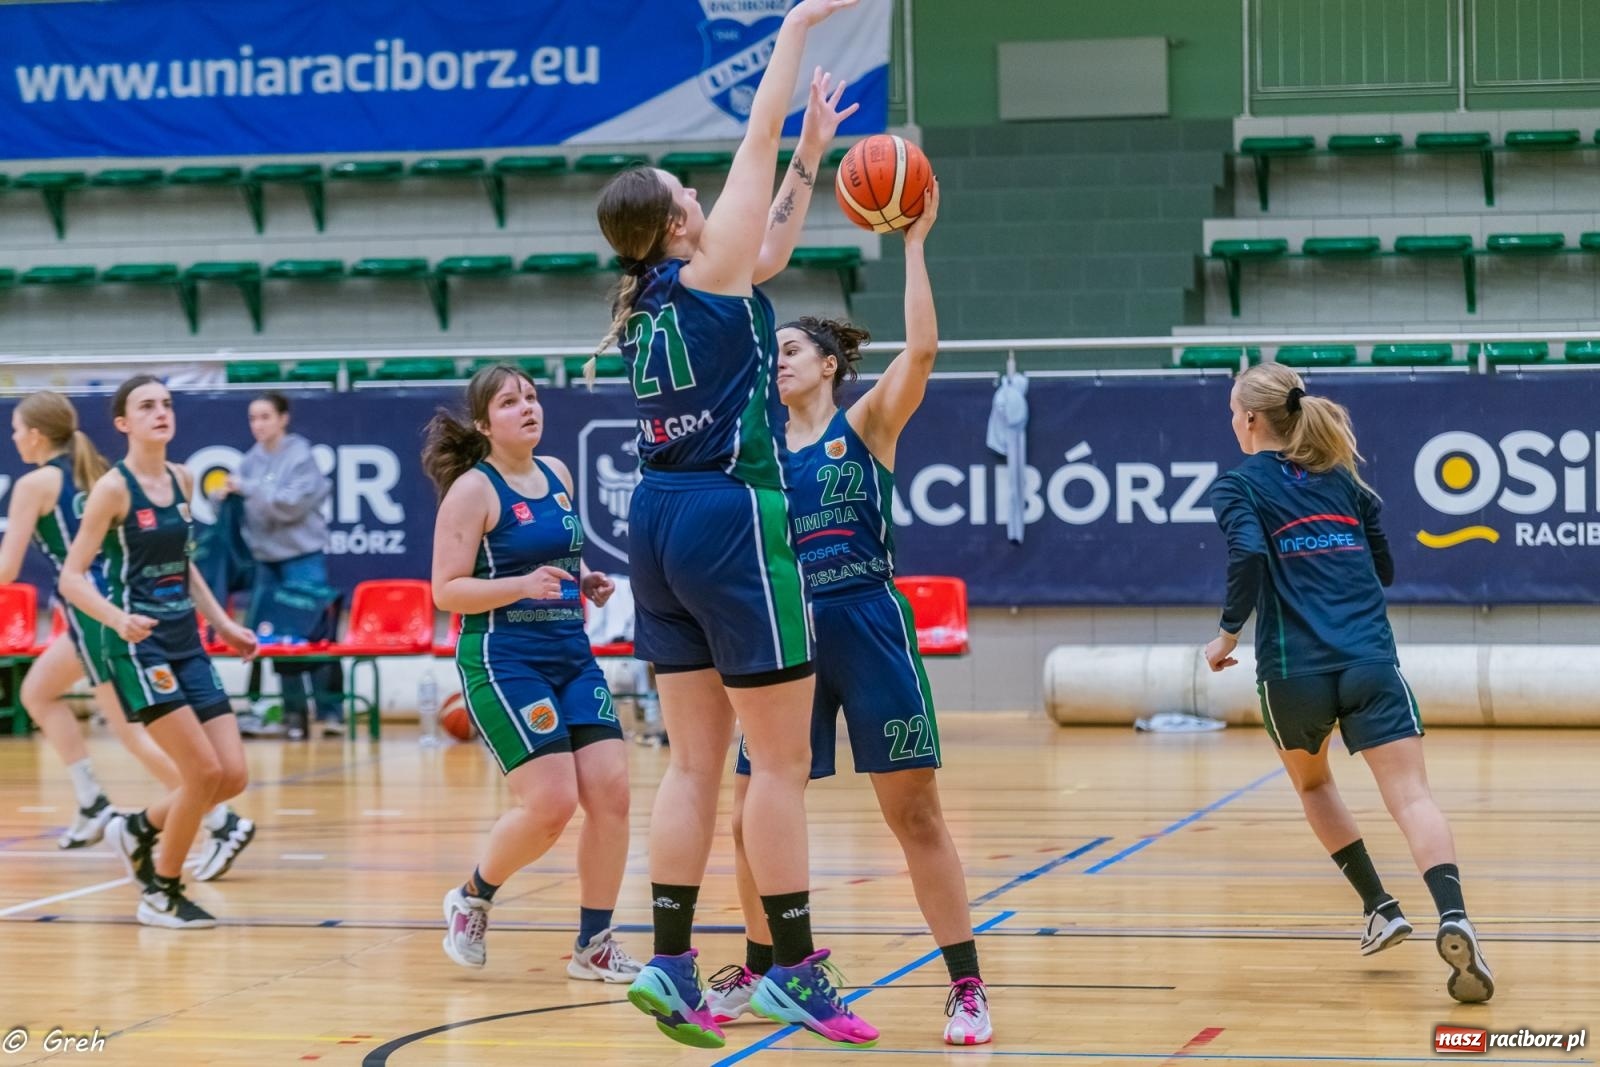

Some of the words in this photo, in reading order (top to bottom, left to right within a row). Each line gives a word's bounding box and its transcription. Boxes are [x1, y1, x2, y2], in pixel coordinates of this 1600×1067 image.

[16, 39, 600, 102] www.uniaraciborz.eu
[624, 302, 697, 399] 21
[817, 461, 867, 506] 22
[1414, 429, 1600, 515] OSi
[1280, 533, 1356, 553] INFOSAFE
[807, 561, 867, 588] ISŁAW
[884, 714, 934, 761] 22
